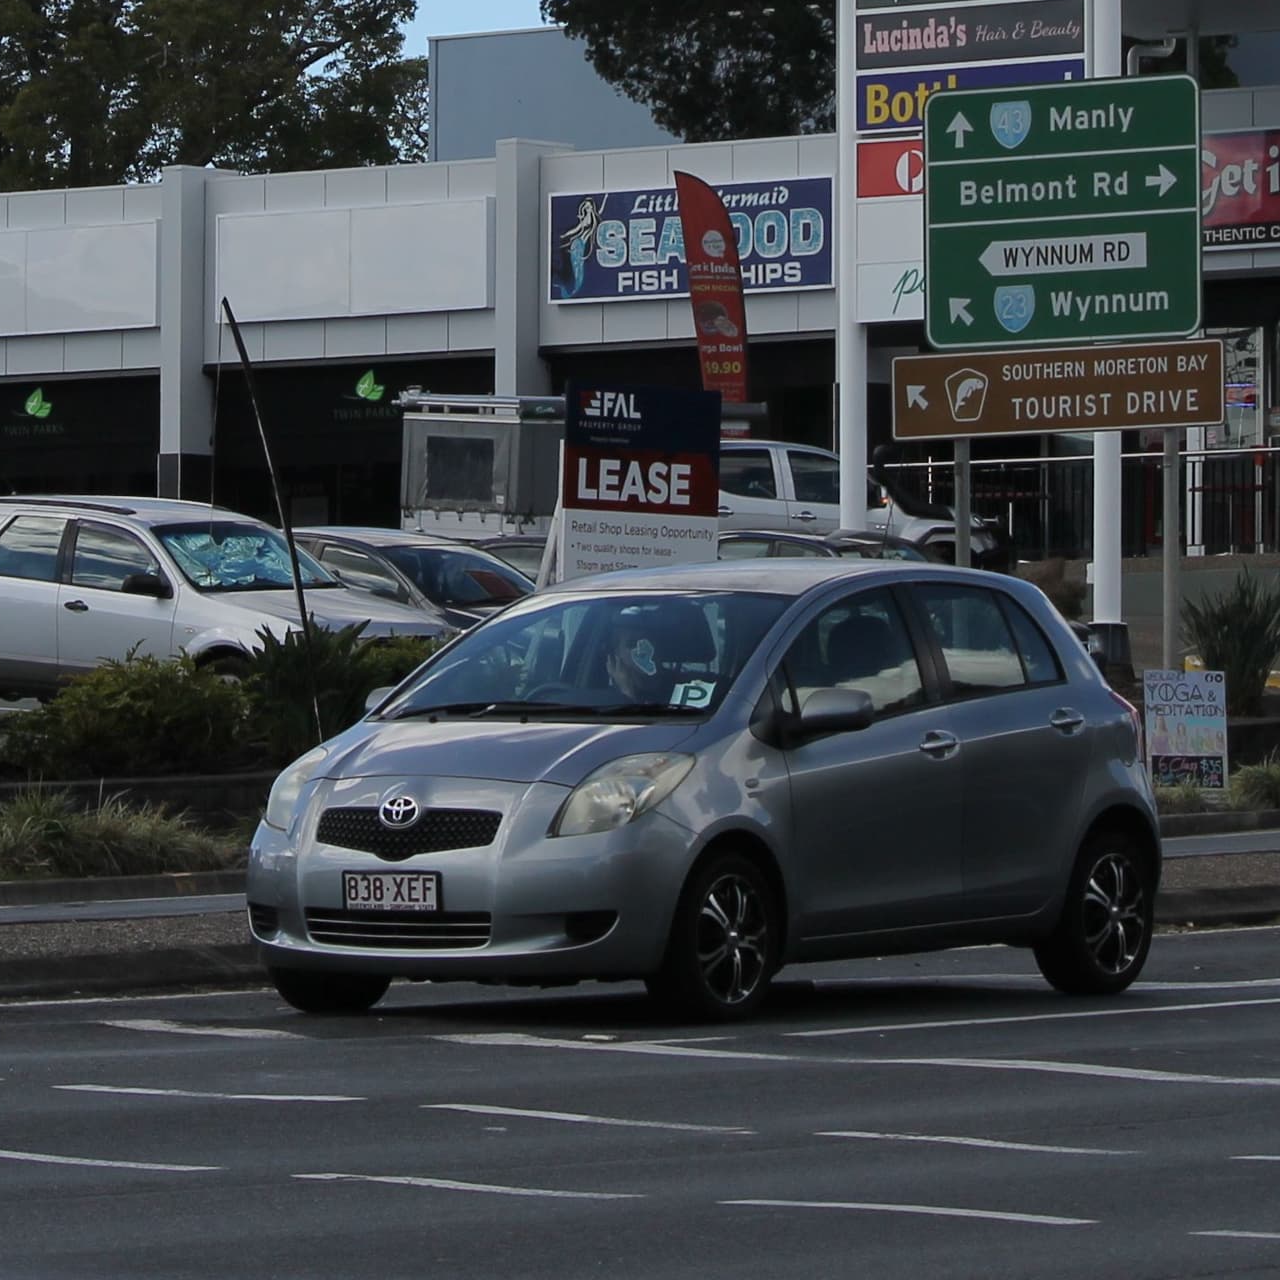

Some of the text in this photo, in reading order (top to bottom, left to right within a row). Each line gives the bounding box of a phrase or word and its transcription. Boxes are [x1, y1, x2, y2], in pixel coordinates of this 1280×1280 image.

[864, 17, 1081, 54] Lucinda's Hair & Beauty
[997, 103, 1134, 132] 43 Manly
[630, 186, 789, 215] Littl ermaid
[960, 172, 1128, 206] Belmont Rd
[596, 207, 824, 269] SEAOOD
[1204, 226, 1266, 242] THENTIC
[1003, 241, 1131, 269] WYNNUM RD
[618, 261, 802, 293] FISH HIPS
[1003, 290, 1169, 321] 23 Wynnum
[1002, 354, 1209, 381] SOUTHERN MORETON BAY
[1011, 388, 1200, 420] TOURIST DRIVE
[577, 457, 691, 506] LEASE
[571, 520, 714, 542] Retail Shop Leasing Opportunity
[576, 542, 672, 557] Two quality shops for lease
[680, 685, 708, 705] P
[1146, 683, 1217, 703] YOGA &
[1146, 704, 1225, 717] MEDITATION
